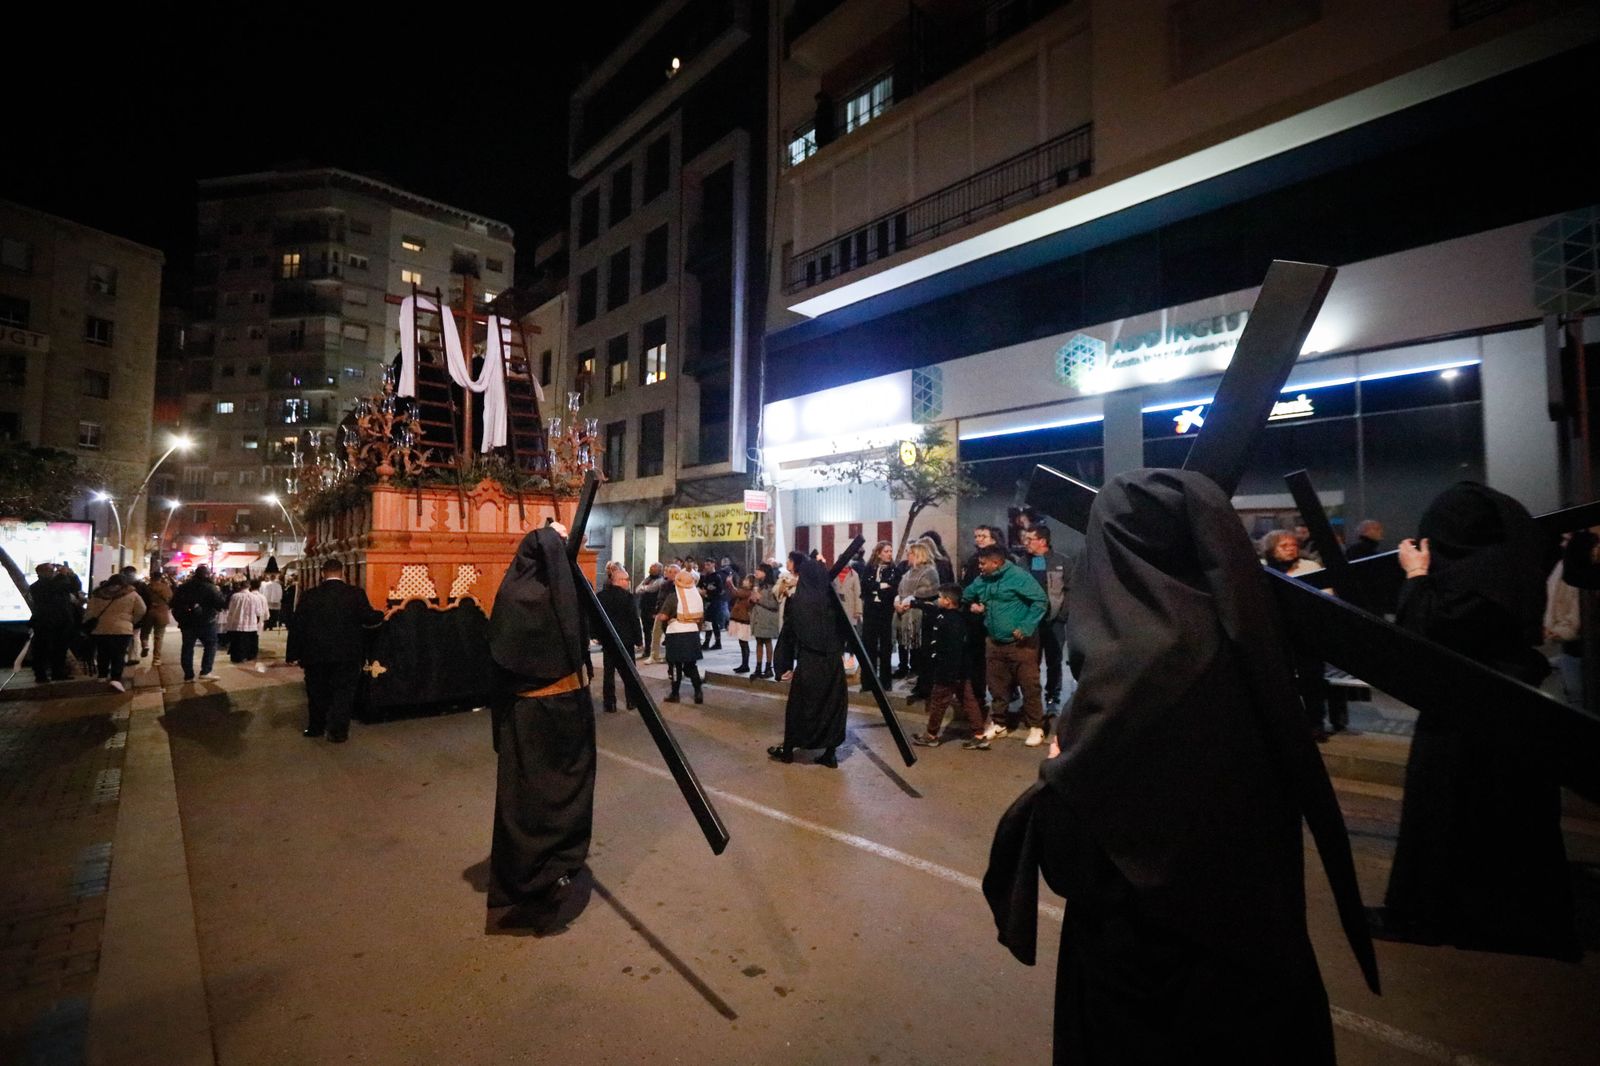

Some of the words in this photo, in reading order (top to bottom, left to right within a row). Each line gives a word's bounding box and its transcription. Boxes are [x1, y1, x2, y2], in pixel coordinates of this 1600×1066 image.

[691, 524, 709, 538] 950
[712, 522, 732, 537] 237
[736, 521, 751, 535] 79
